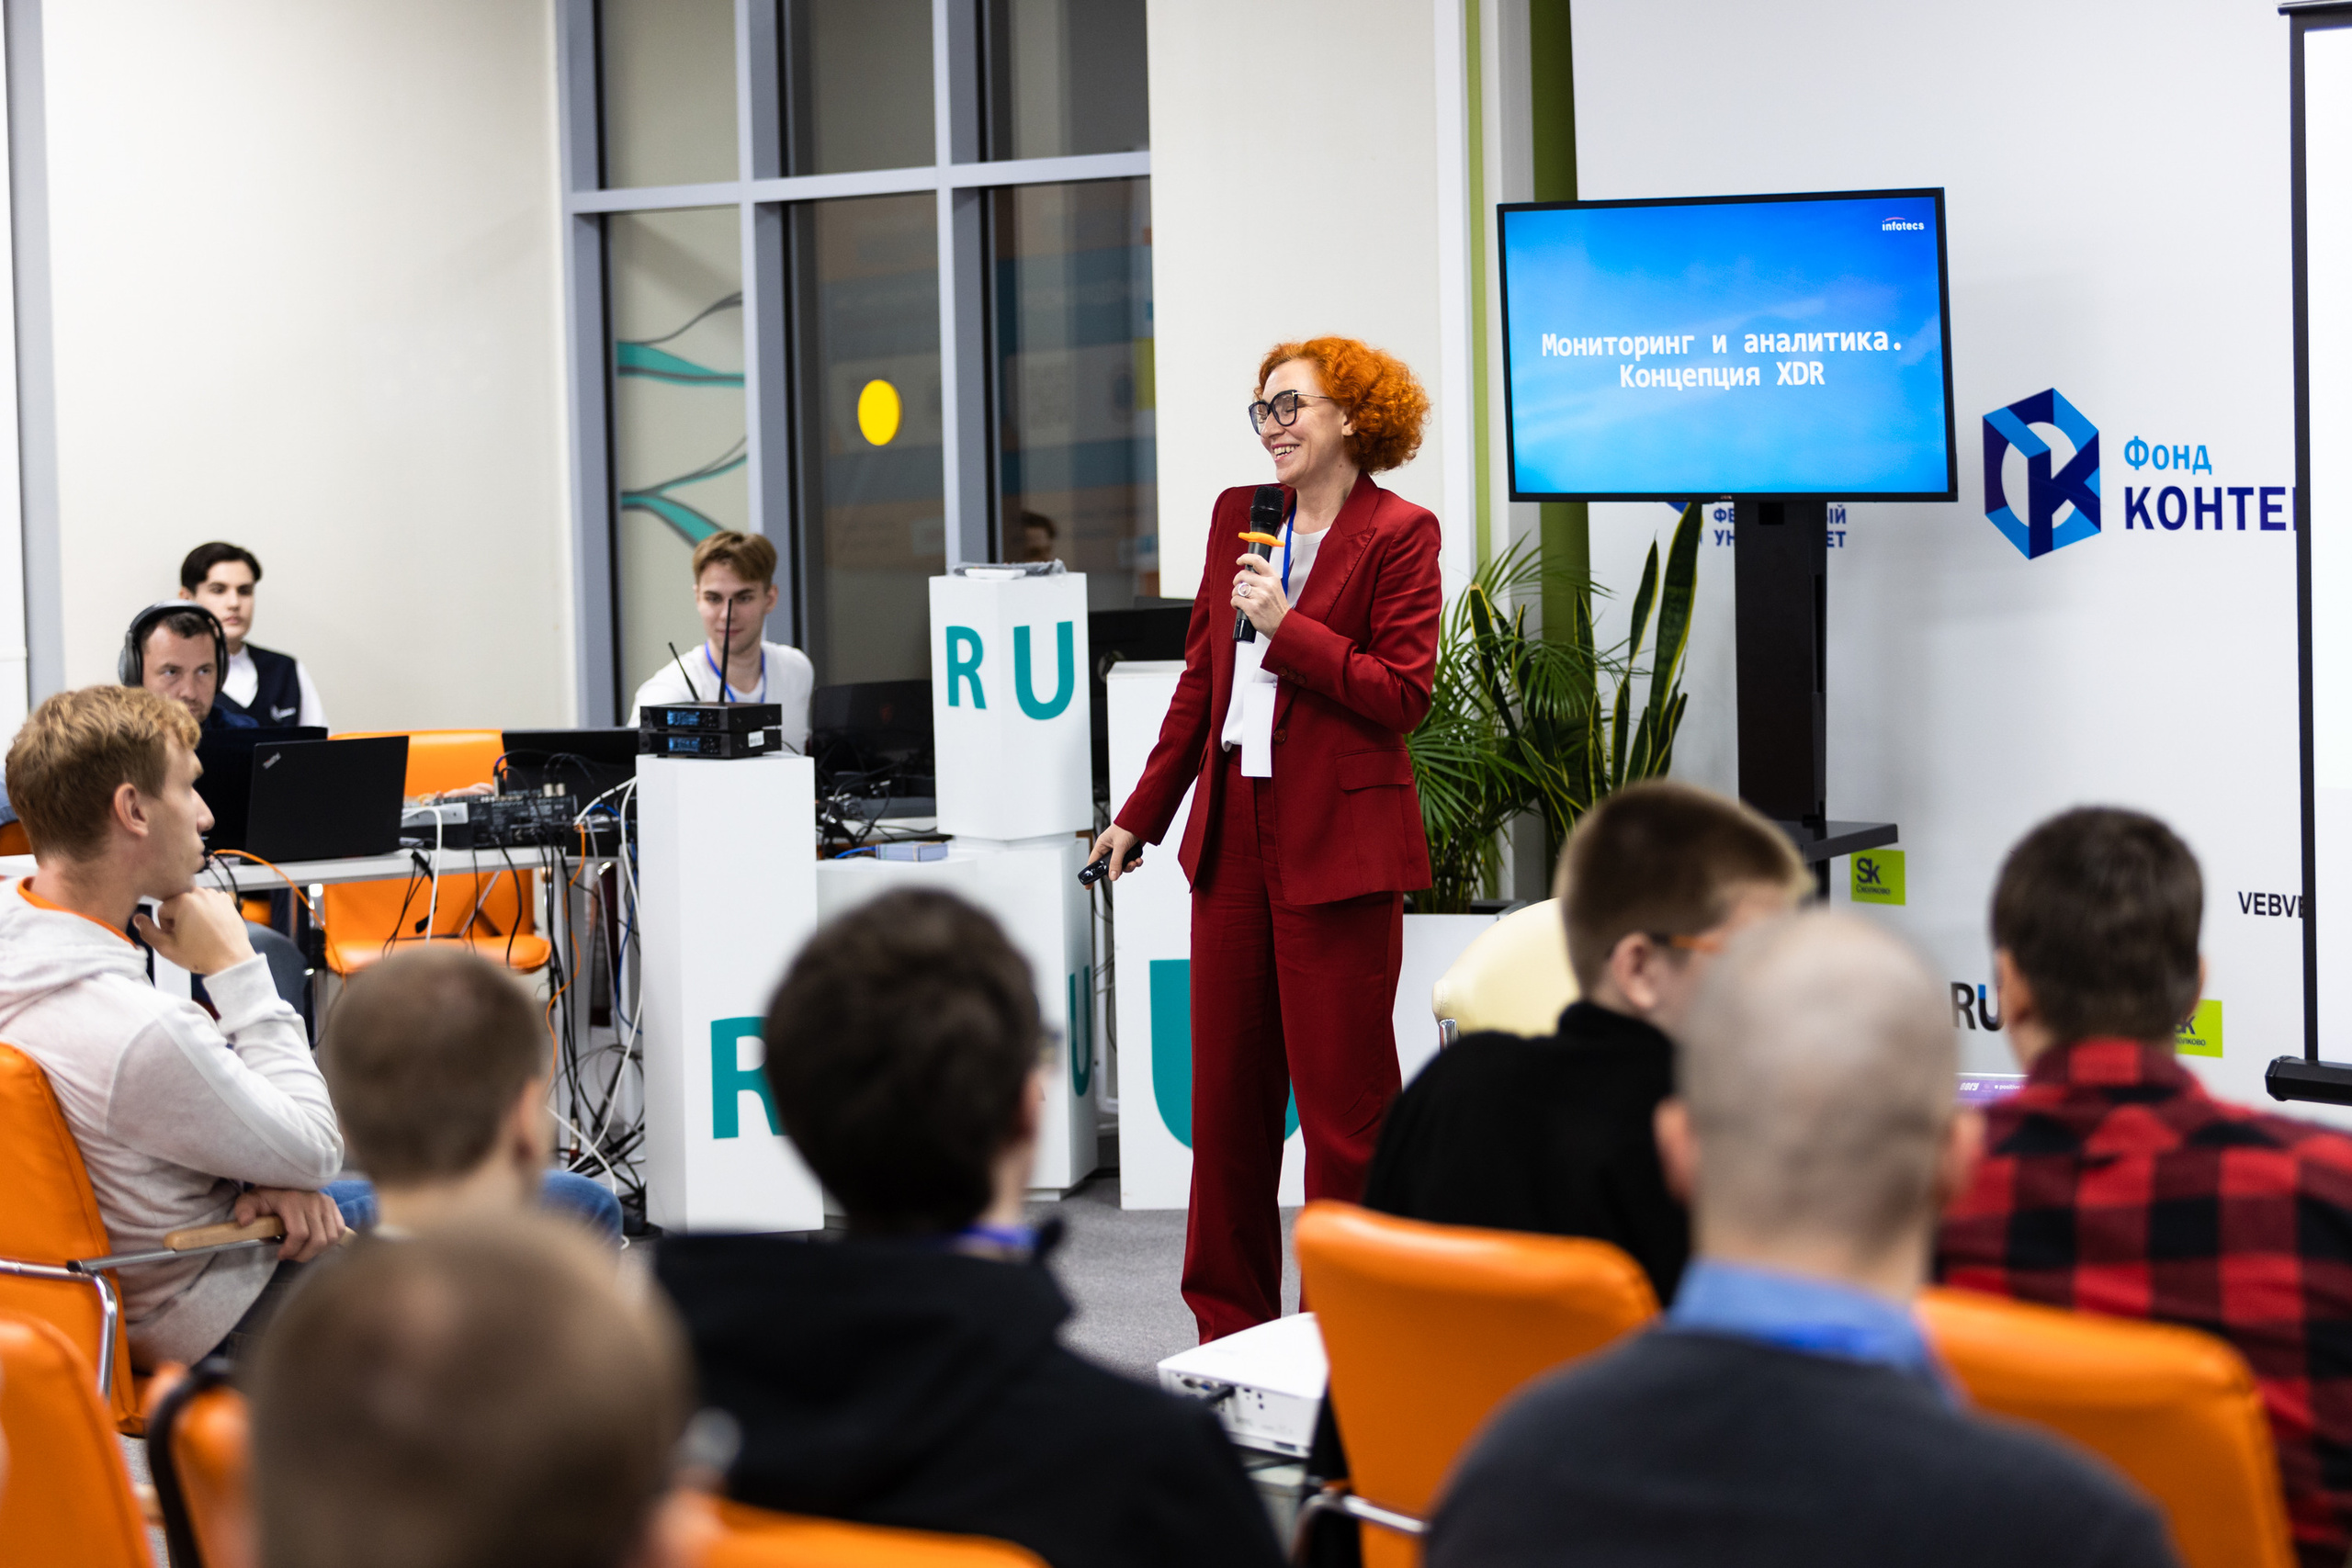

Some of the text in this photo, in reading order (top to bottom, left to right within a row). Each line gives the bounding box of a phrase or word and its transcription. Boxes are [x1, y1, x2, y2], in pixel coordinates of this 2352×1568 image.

[1882, 220, 1925, 231] infotecs
[1541, 330, 1903, 362] Мониторинг и аналитика.
[1620, 361, 1826, 390] Концепция XDR
[2124, 435, 2212, 475] Фонд
[2124, 486, 2297, 531] КОНТЕ
[1856, 857, 1881, 885] Sk
